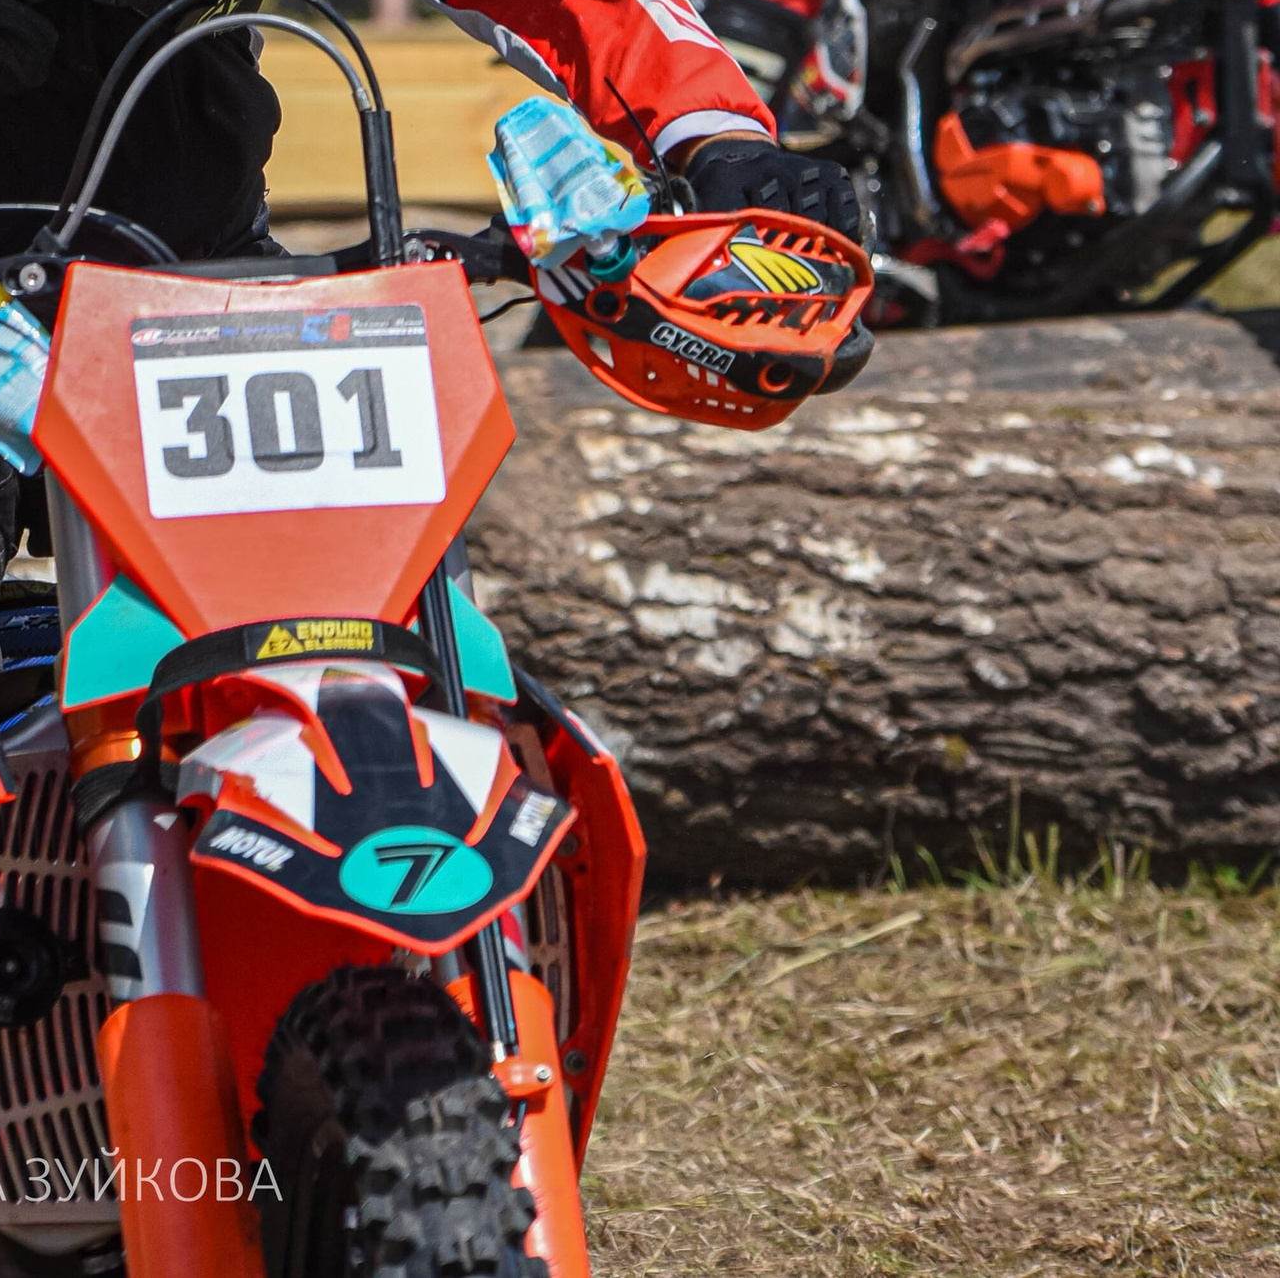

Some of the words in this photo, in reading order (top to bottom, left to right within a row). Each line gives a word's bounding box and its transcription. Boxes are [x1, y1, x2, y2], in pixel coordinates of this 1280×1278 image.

[651, 324, 735, 373] CYCRA
[157, 367, 403, 478] 301
[296, 620, 373, 640] ENDURO
[303, 638, 374, 651] ELEMENT
[211, 825, 294, 872] MOTUL
[373, 843, 459, 909] 7
